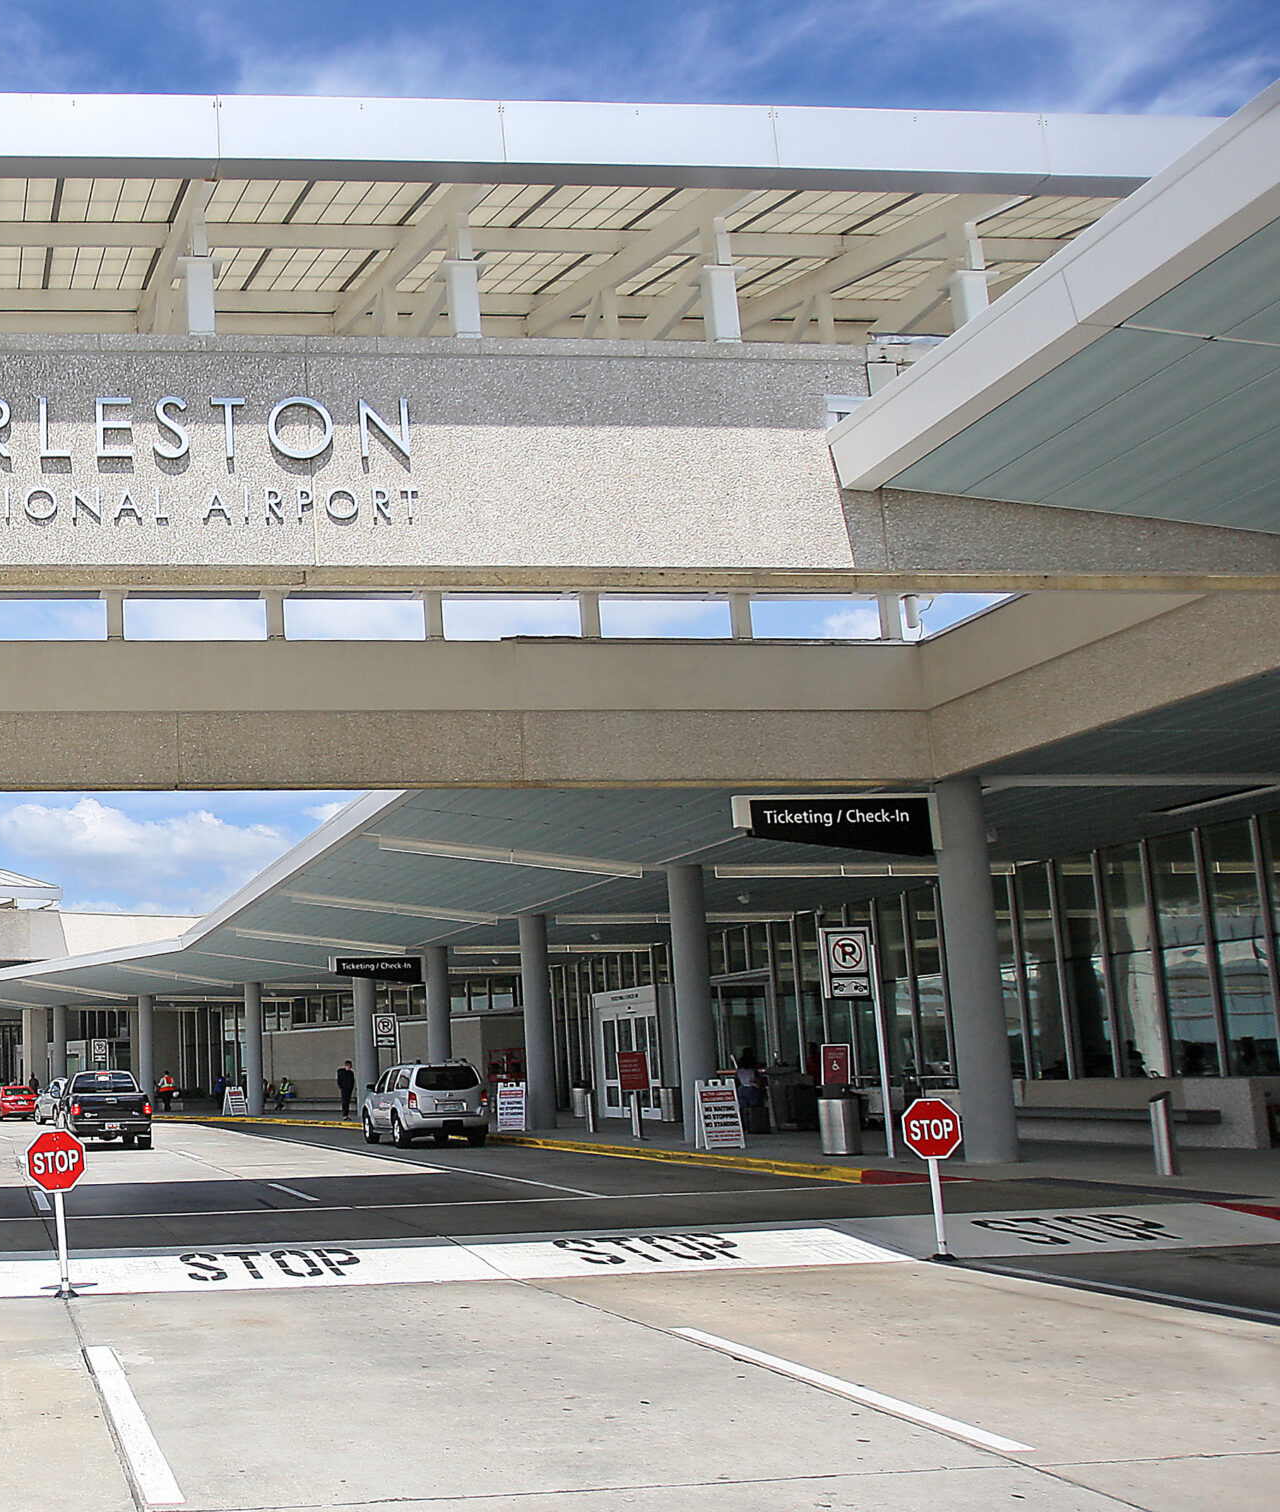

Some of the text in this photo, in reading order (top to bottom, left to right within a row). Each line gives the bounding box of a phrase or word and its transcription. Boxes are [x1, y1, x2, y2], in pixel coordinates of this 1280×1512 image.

[203, 486, 419, 520] AIRPORT
[763, 809, 910, 827] Ticketing / Check-In
[341, 963, 375, 971] Ticketing
[910, 1118, 953, 1141] STOP
[33, 1149, 80, 1175] STOP
[970, 1213, 1183, 1245] STOP
[552, 1233, 742, 1265] STOP
[179, 1248, 361, 1281] STOP
